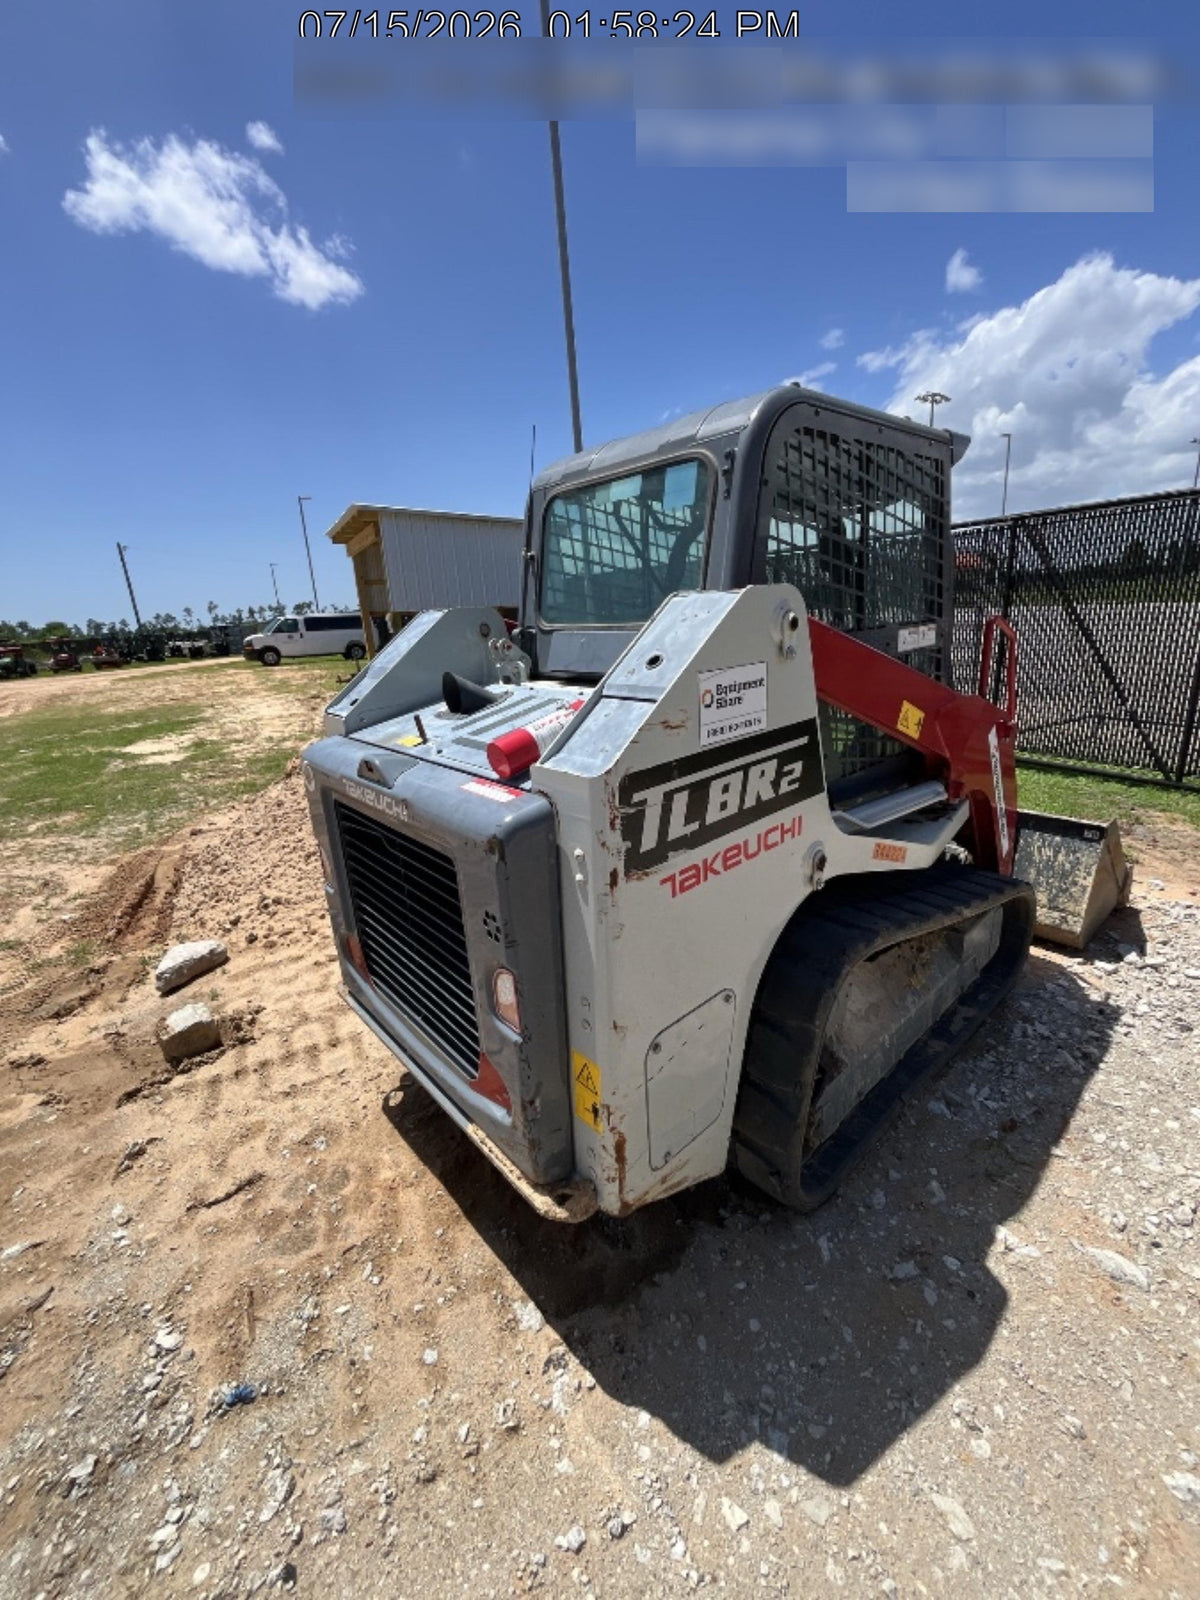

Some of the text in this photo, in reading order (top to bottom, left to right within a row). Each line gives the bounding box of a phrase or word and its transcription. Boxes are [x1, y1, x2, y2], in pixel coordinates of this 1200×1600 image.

[715, 677, 765, 697] Equipment
[715, 693, 745, 711] Share
[342, 779, 408, 822] TAKEUCHI
[659, 815, 803, 898] TAKEUCHI
